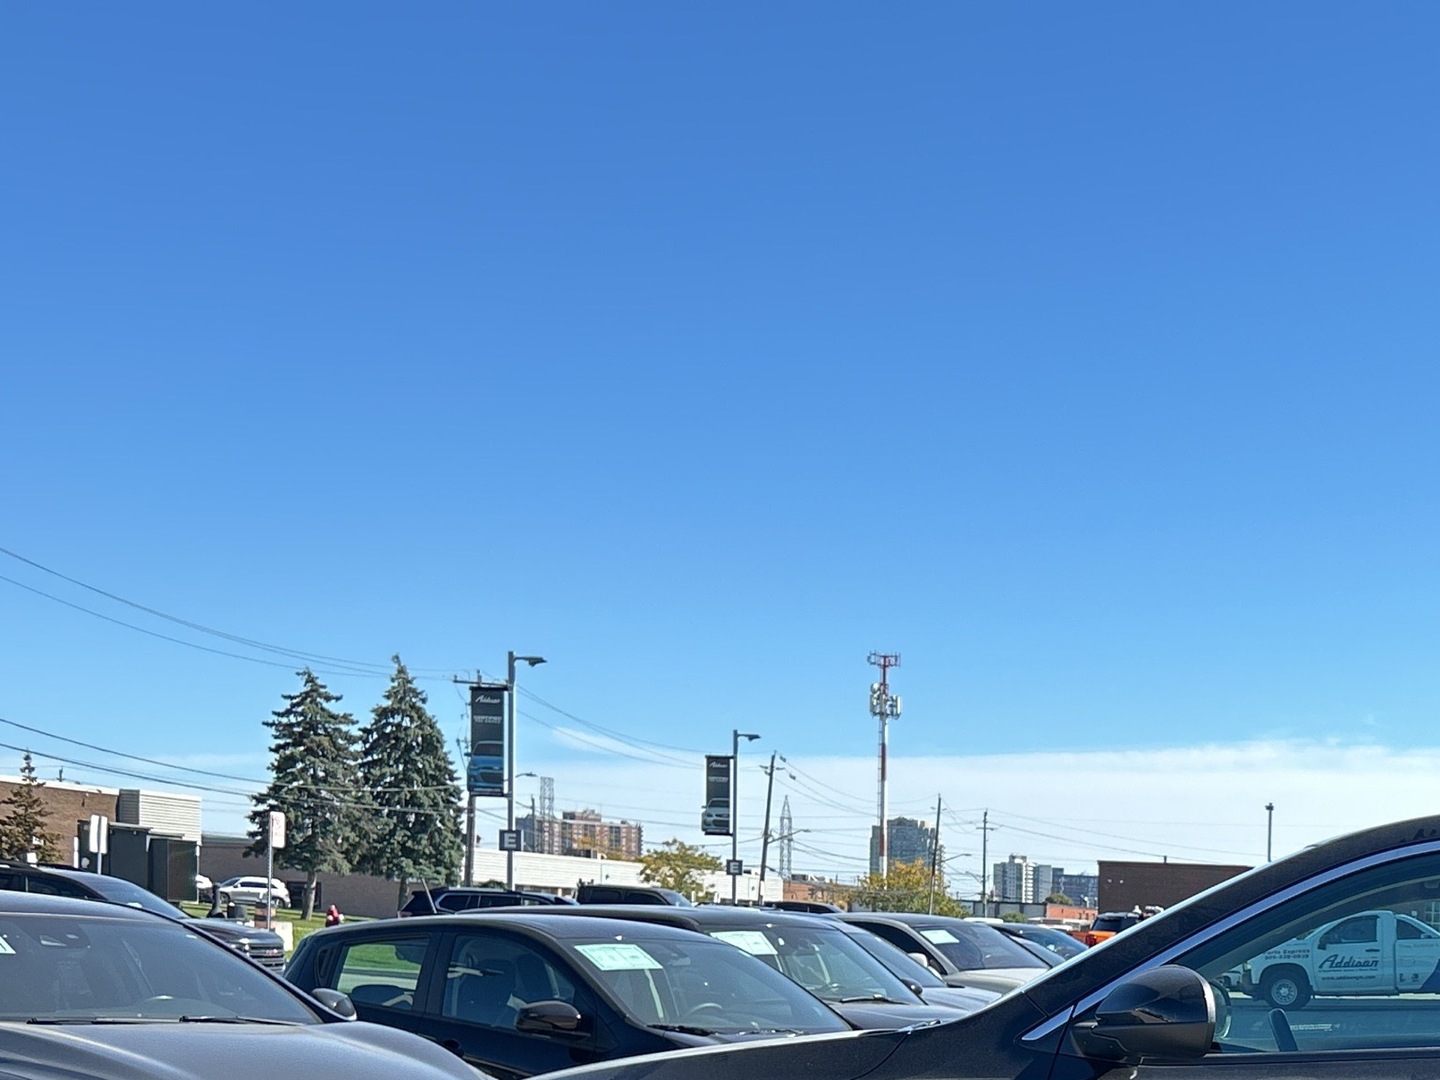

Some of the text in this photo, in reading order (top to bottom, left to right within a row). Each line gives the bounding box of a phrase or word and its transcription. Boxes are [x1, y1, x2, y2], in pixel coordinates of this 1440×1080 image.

[504, 832, 517, 849] E
[729, 861, 740, 874] E
[1318, 953, 1379, 969] Addison
